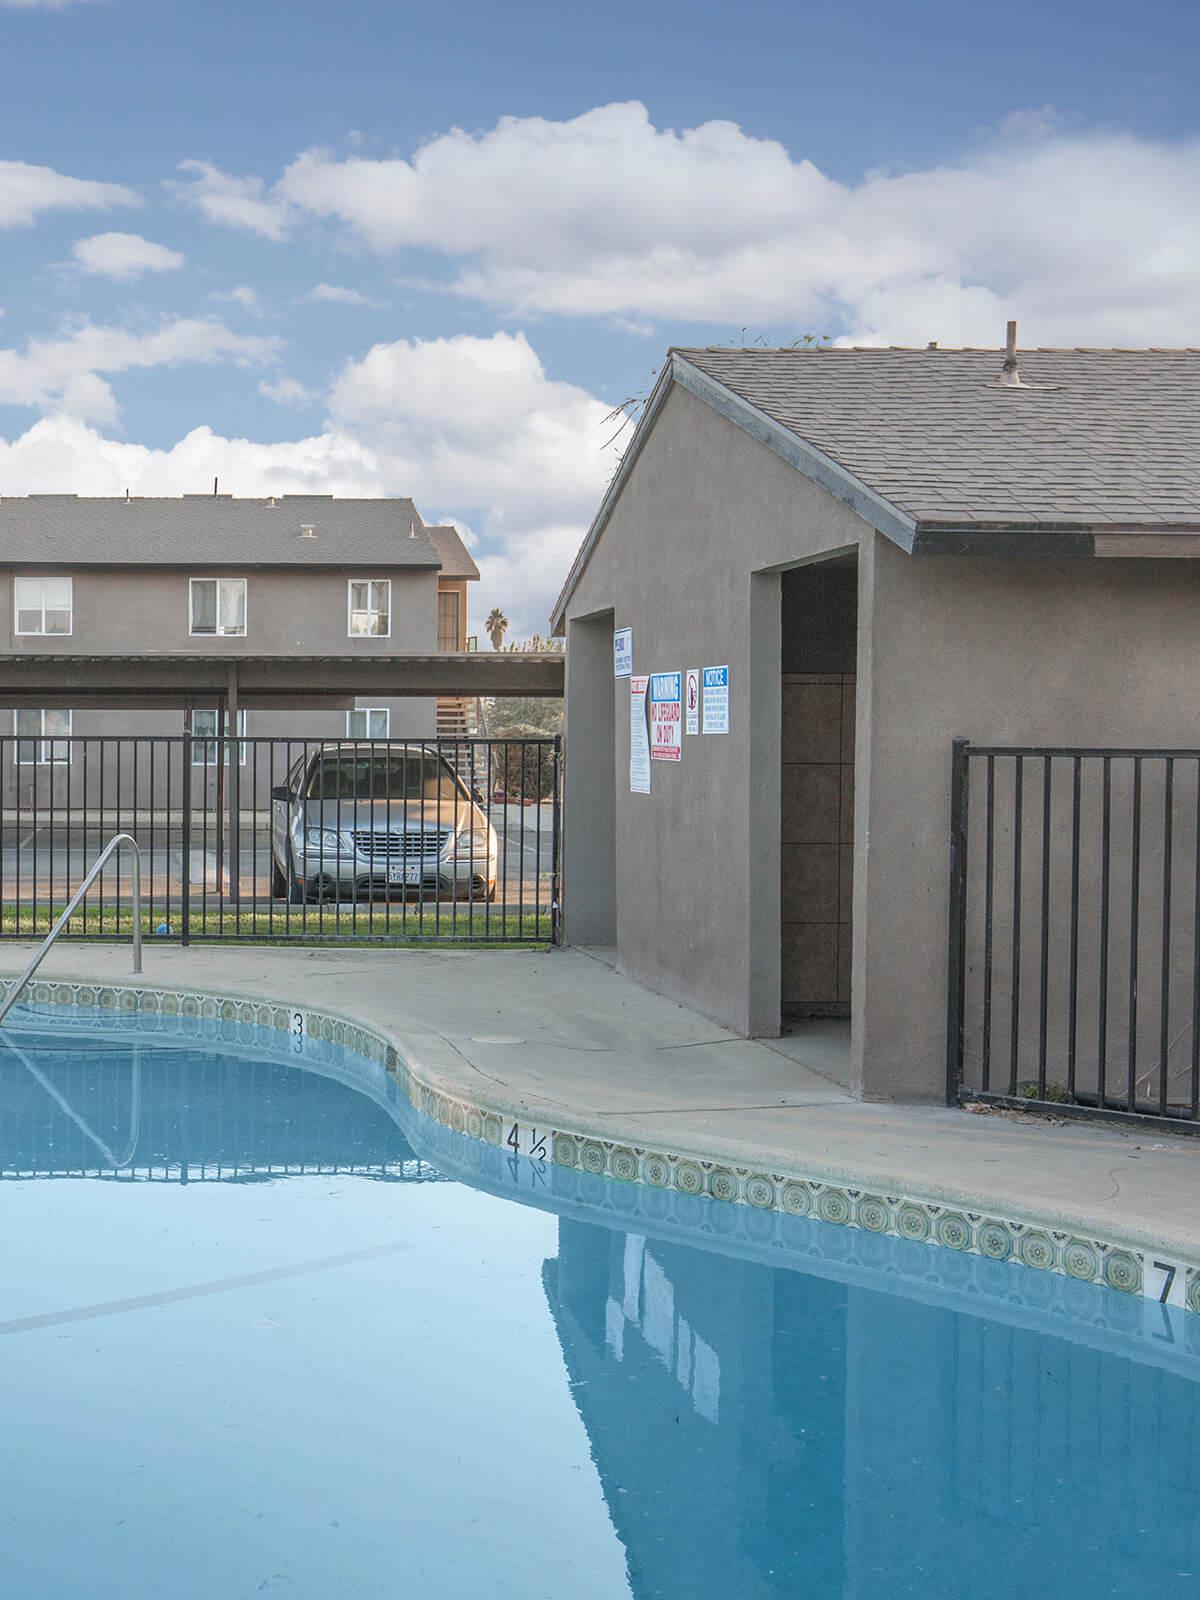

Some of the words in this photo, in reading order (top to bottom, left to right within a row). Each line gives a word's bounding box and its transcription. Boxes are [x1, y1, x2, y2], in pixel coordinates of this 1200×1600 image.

[653, 675, 679, 699] WARNING
[705, 669, 724, 685] NOTICE
[651, 703, 657, 721] NO
[658, 702, 680, 721] LIFEGUARD
[656, 725, 663, 743] ON
[663, 725, 674, 744] DUTY
[293, 1013, 303, 1035] 3
[507, 1122, 520, 1154] 4
[1153, 1261, 1177, 1304] 7
